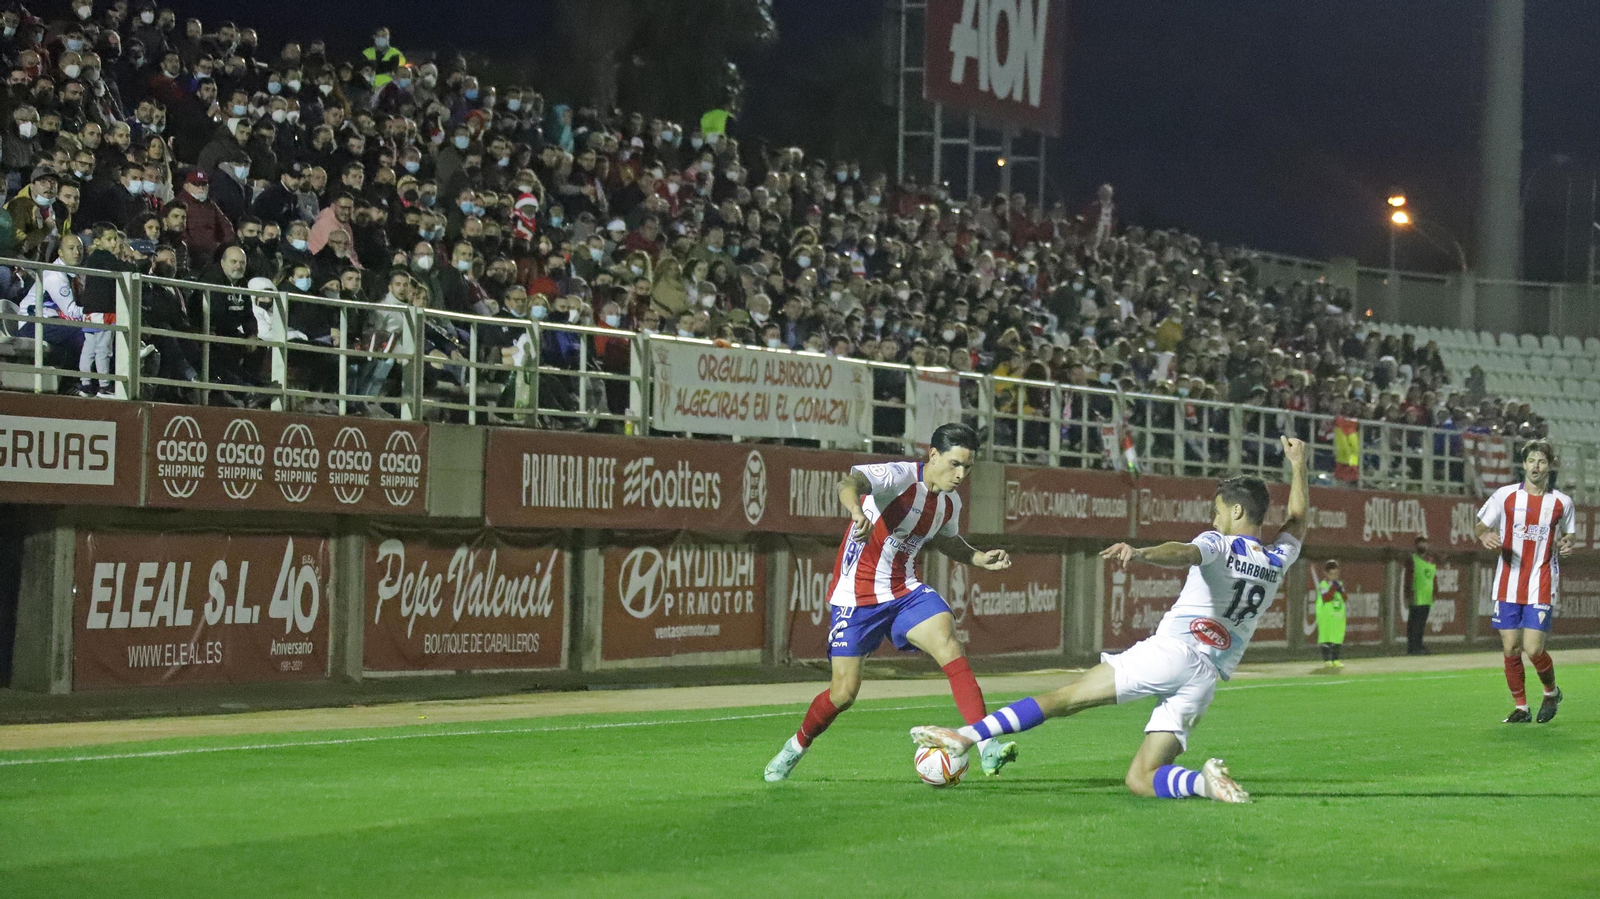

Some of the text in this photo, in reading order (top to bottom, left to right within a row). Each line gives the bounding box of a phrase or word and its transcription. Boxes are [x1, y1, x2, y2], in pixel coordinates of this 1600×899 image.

[698, 353, 832, 389] ORGULLO ALBIRROJO
[674, 387, 749, 421] ALGECIRAS
[753, 392, 770, 422] EN
[776, 393, 789, 421] EL
[157, 439, 208, 463] COSCO
[216, 442, 265, 466] COSCO
[273, 446, 320, 469] COSCO
[327, 449, 372, 472] COSCO
[379, 452, 421, 474] COSCO
[158, 463, 205, 478] SHIPPING
[217, 466, 263, 480] SHIPPING
[274, 469, 317, 484] SHIPPING
[328, 472, 370, 486] SHIPPING
[380, 474, 419, 488] SHIPPING
[522, 452, 721, 510] PRIMERA RFEF Footters
[789, 467, 838, 518] PRIMERA
[86, 559, 261, 630] ELEAL S.L.
[268, 535, 320, 635] 40
[375, 539, 443, 639] Pepe
[664, 590, 754, 617] PIRMOTOR
[971, 583, 1026, 616] Grazalema
[1223, 580, 1267, 621] 18
[127, 641, 223, 668] WWW.ELEAL.ES
[270, 636, 314, 656] Aniversario
[424, 632, 540, 654] BOUTIQUE DE CABALLEROS
